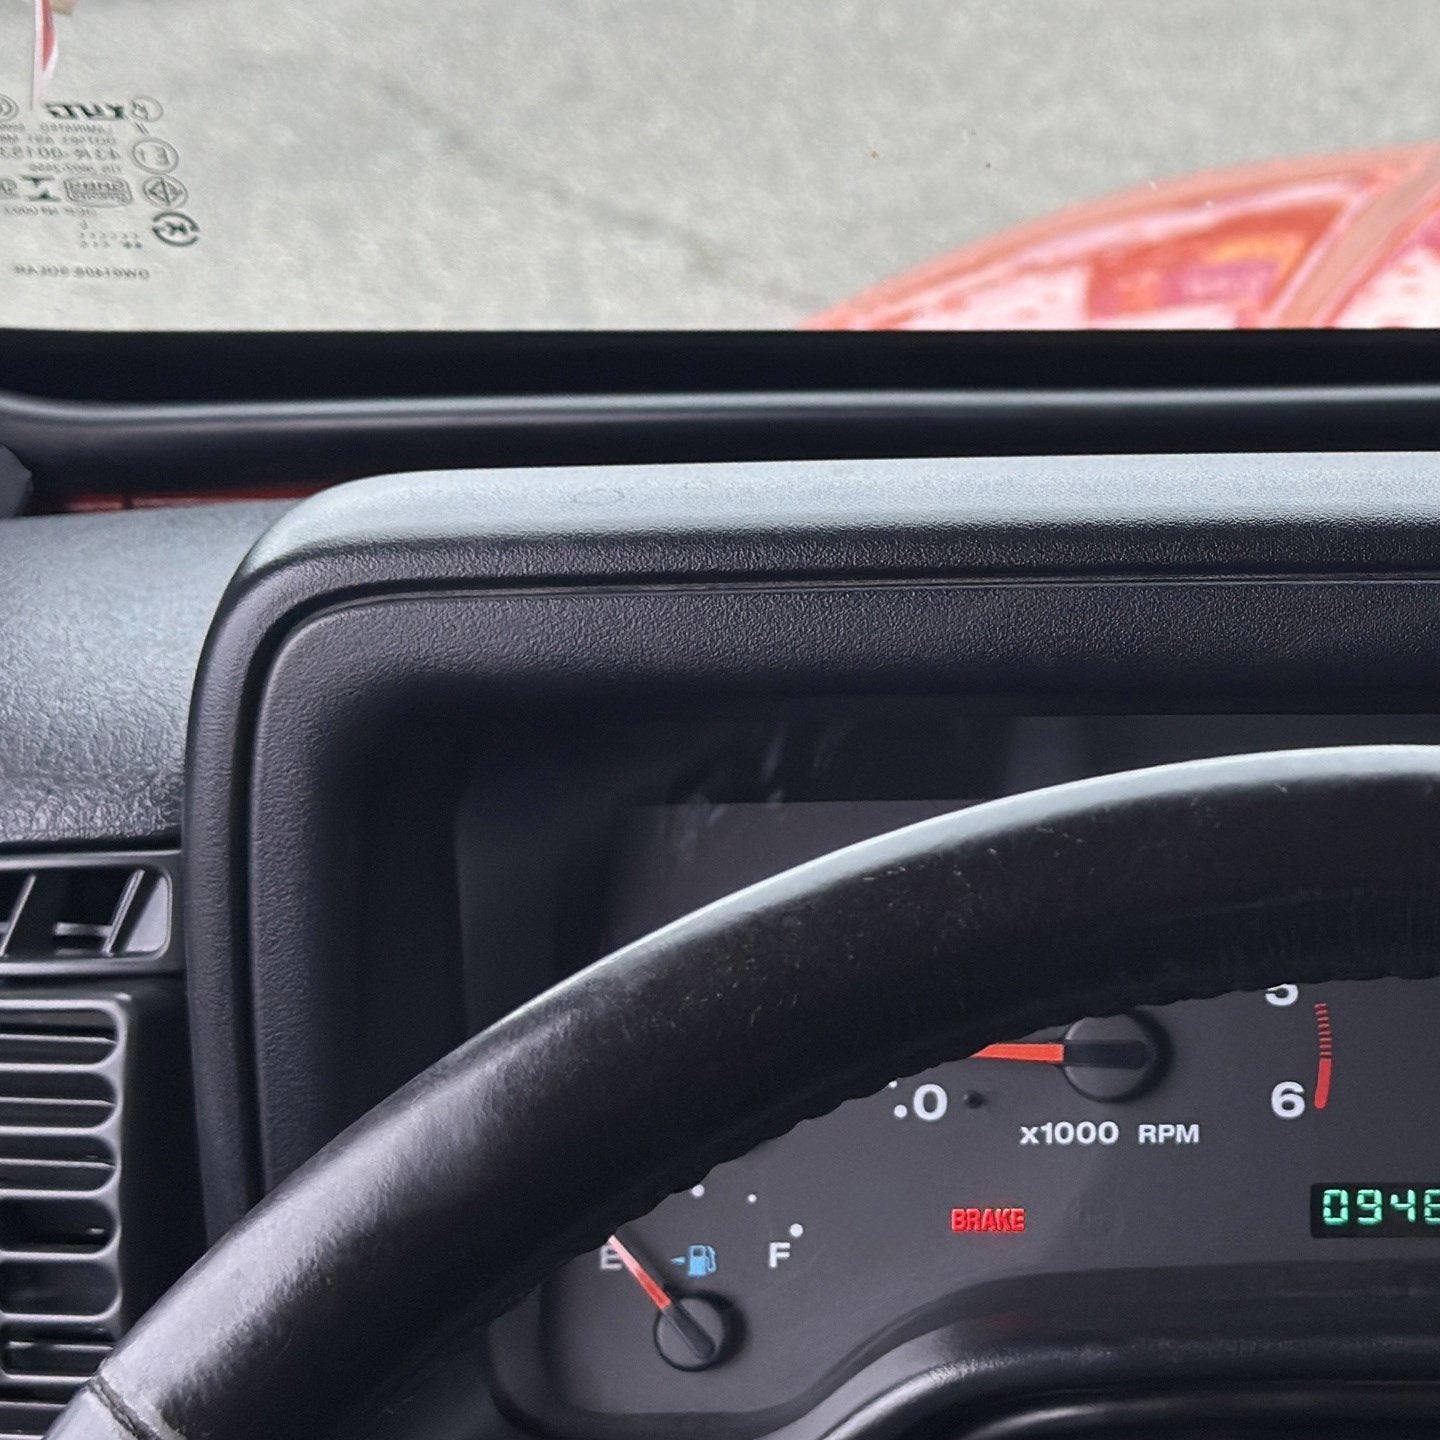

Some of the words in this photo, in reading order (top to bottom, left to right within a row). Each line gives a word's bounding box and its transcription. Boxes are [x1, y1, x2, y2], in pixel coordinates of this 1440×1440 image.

[912, 1084, 949, 1122] 0
[1270, 1080, 1306, 1119] 6
[1019, 1122, 1120, 1147] x1000
[1138, 1123, 1201, 1145] RPM
[950, 1207, 1027, 1234] BRAKE
[767, 1241, 792, 1269] F
